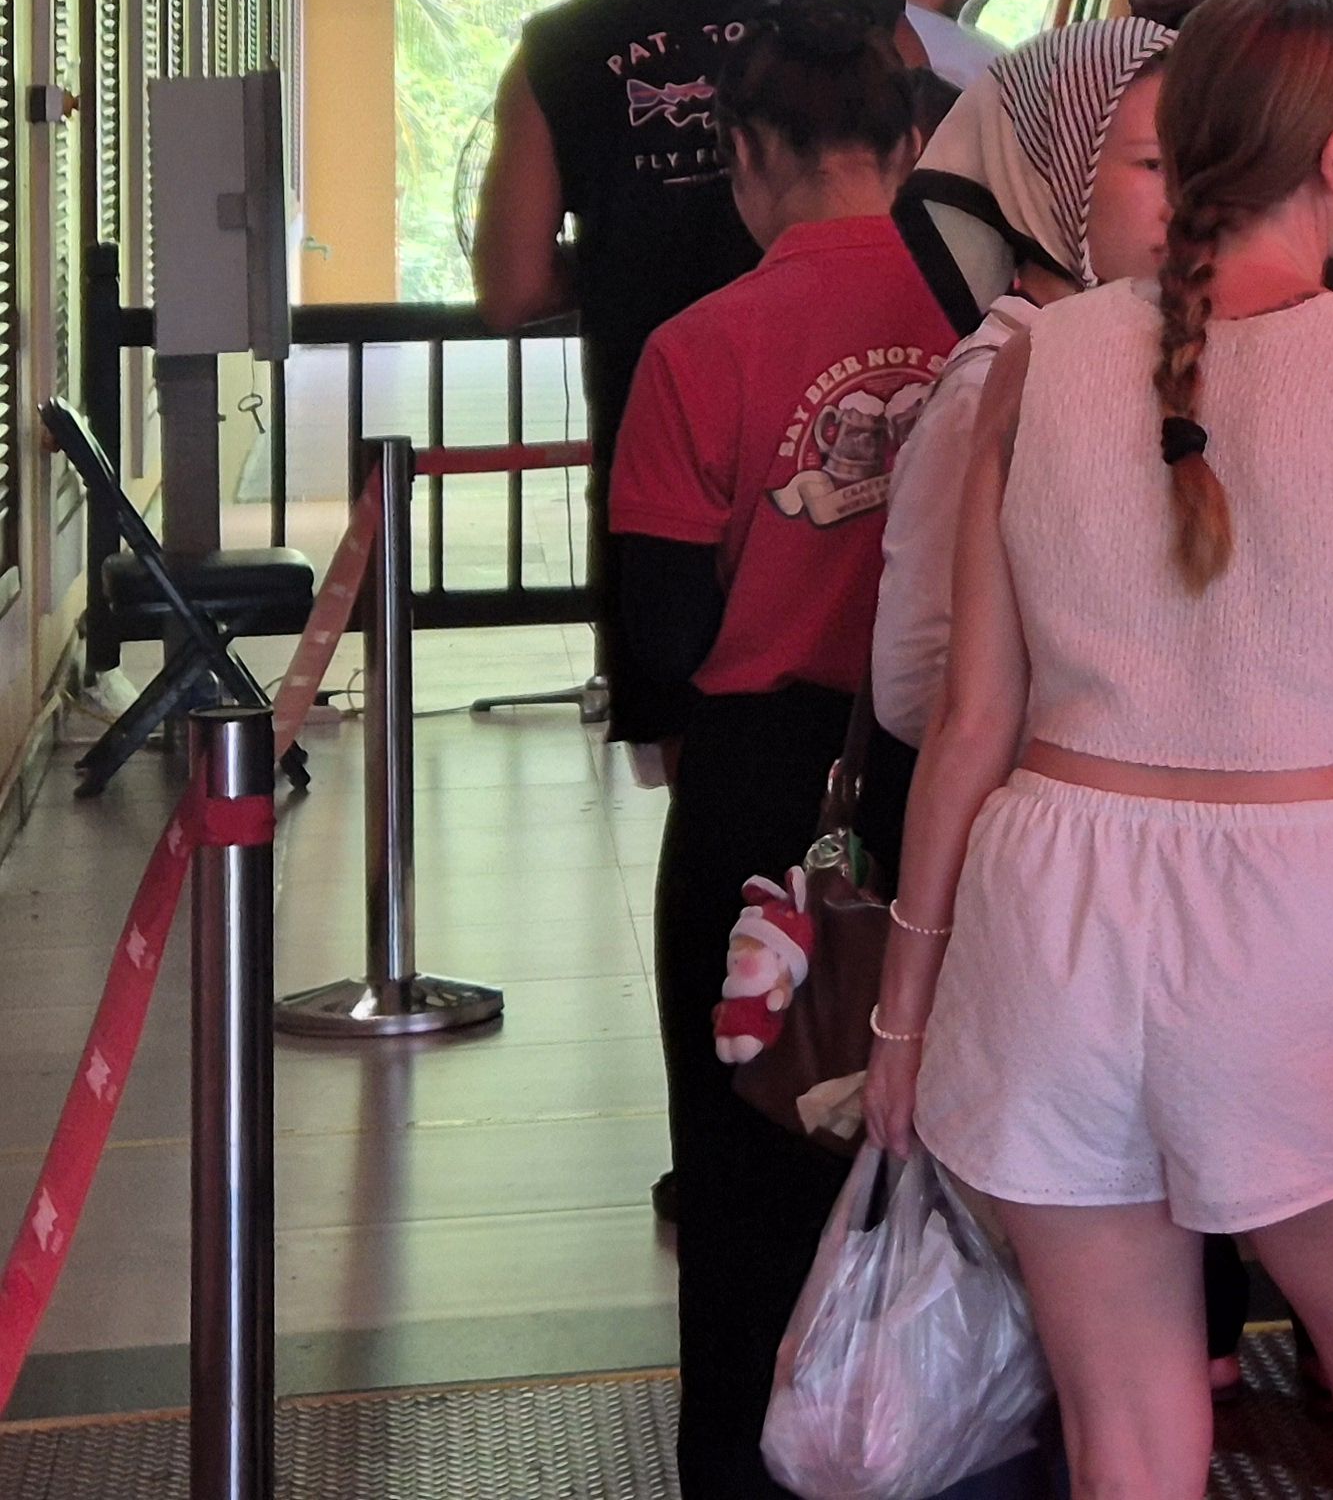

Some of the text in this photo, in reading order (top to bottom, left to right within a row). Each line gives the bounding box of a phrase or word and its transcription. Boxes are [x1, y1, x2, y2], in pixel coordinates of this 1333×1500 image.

[635, 151, 679, 171] FLY
[805, 356, 863, 404] BEER
[867, 346, 923, 368] NOT
